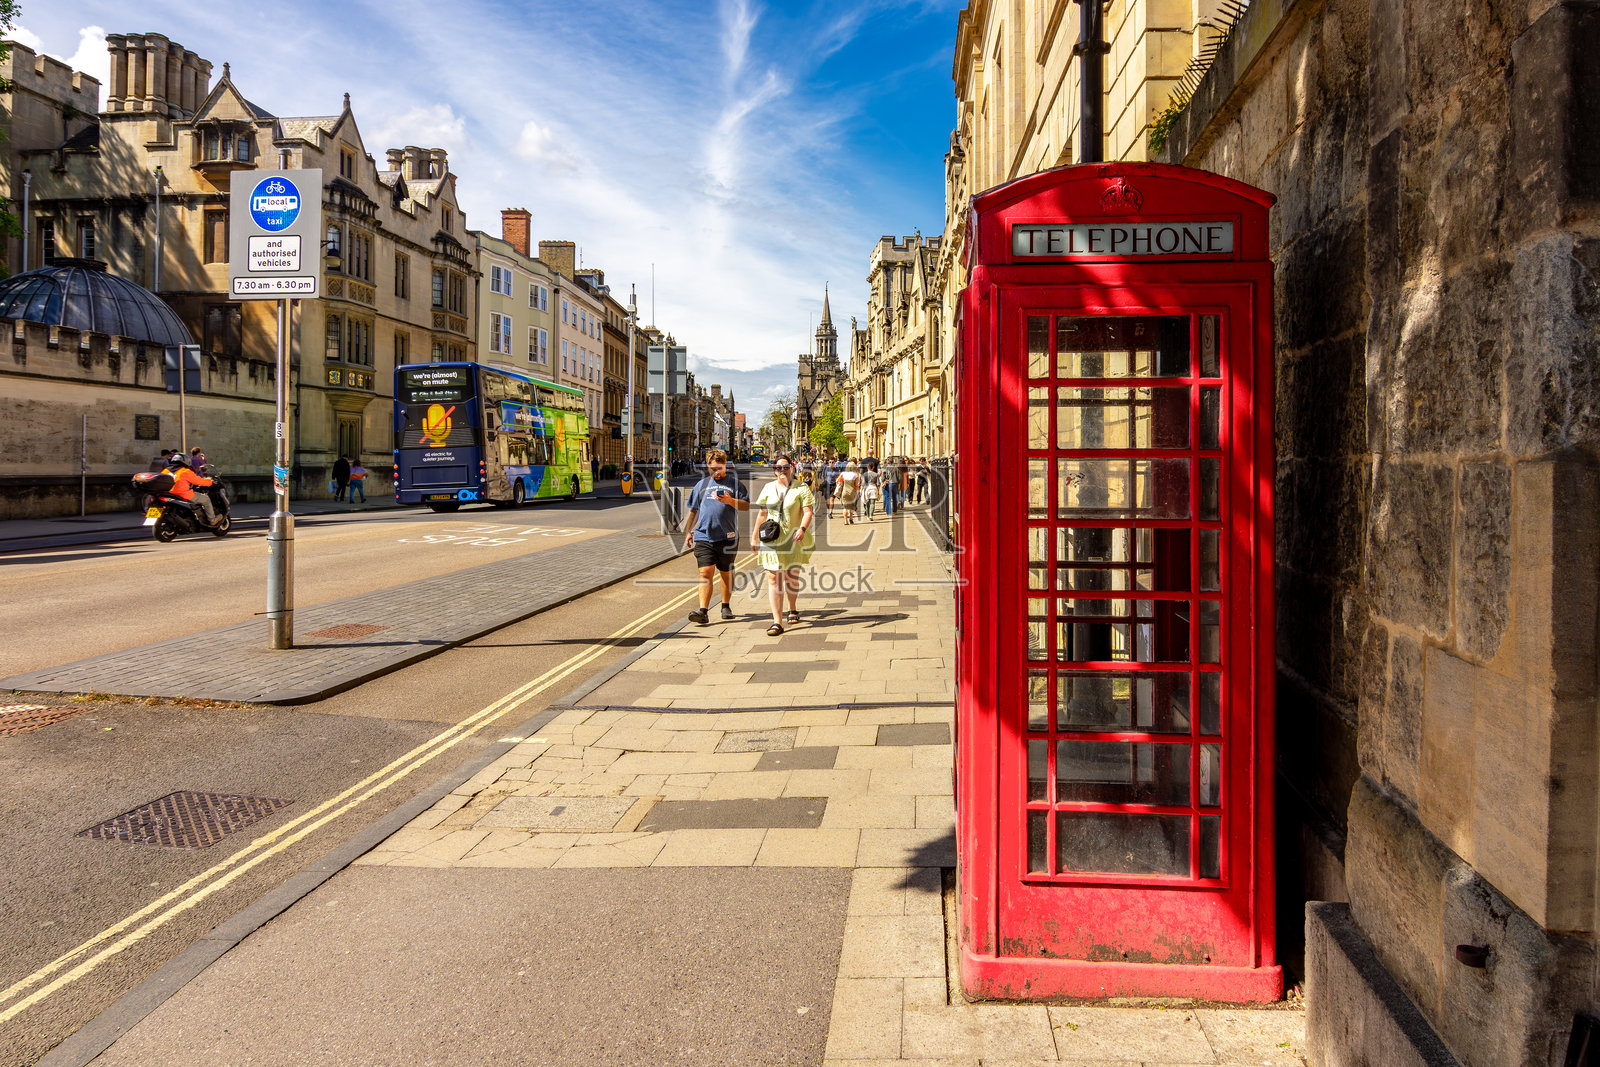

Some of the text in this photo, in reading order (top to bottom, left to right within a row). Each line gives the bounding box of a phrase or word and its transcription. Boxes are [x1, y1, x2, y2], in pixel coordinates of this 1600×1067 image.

[267, 197, 288, 206] local
[267, 217, 283, 225] taxi
[1021, 226, 1224, 254] TELEPHONE
[252, 249, 297, 257] authorised
[257, 259, 291, 267] vehicles
[237, 281, 256, 289] 7.30
[276, 280, 296, 289] 6.30
[431, 371, 458, 379] (almost)
[458, 489, 478, 501] Ox
